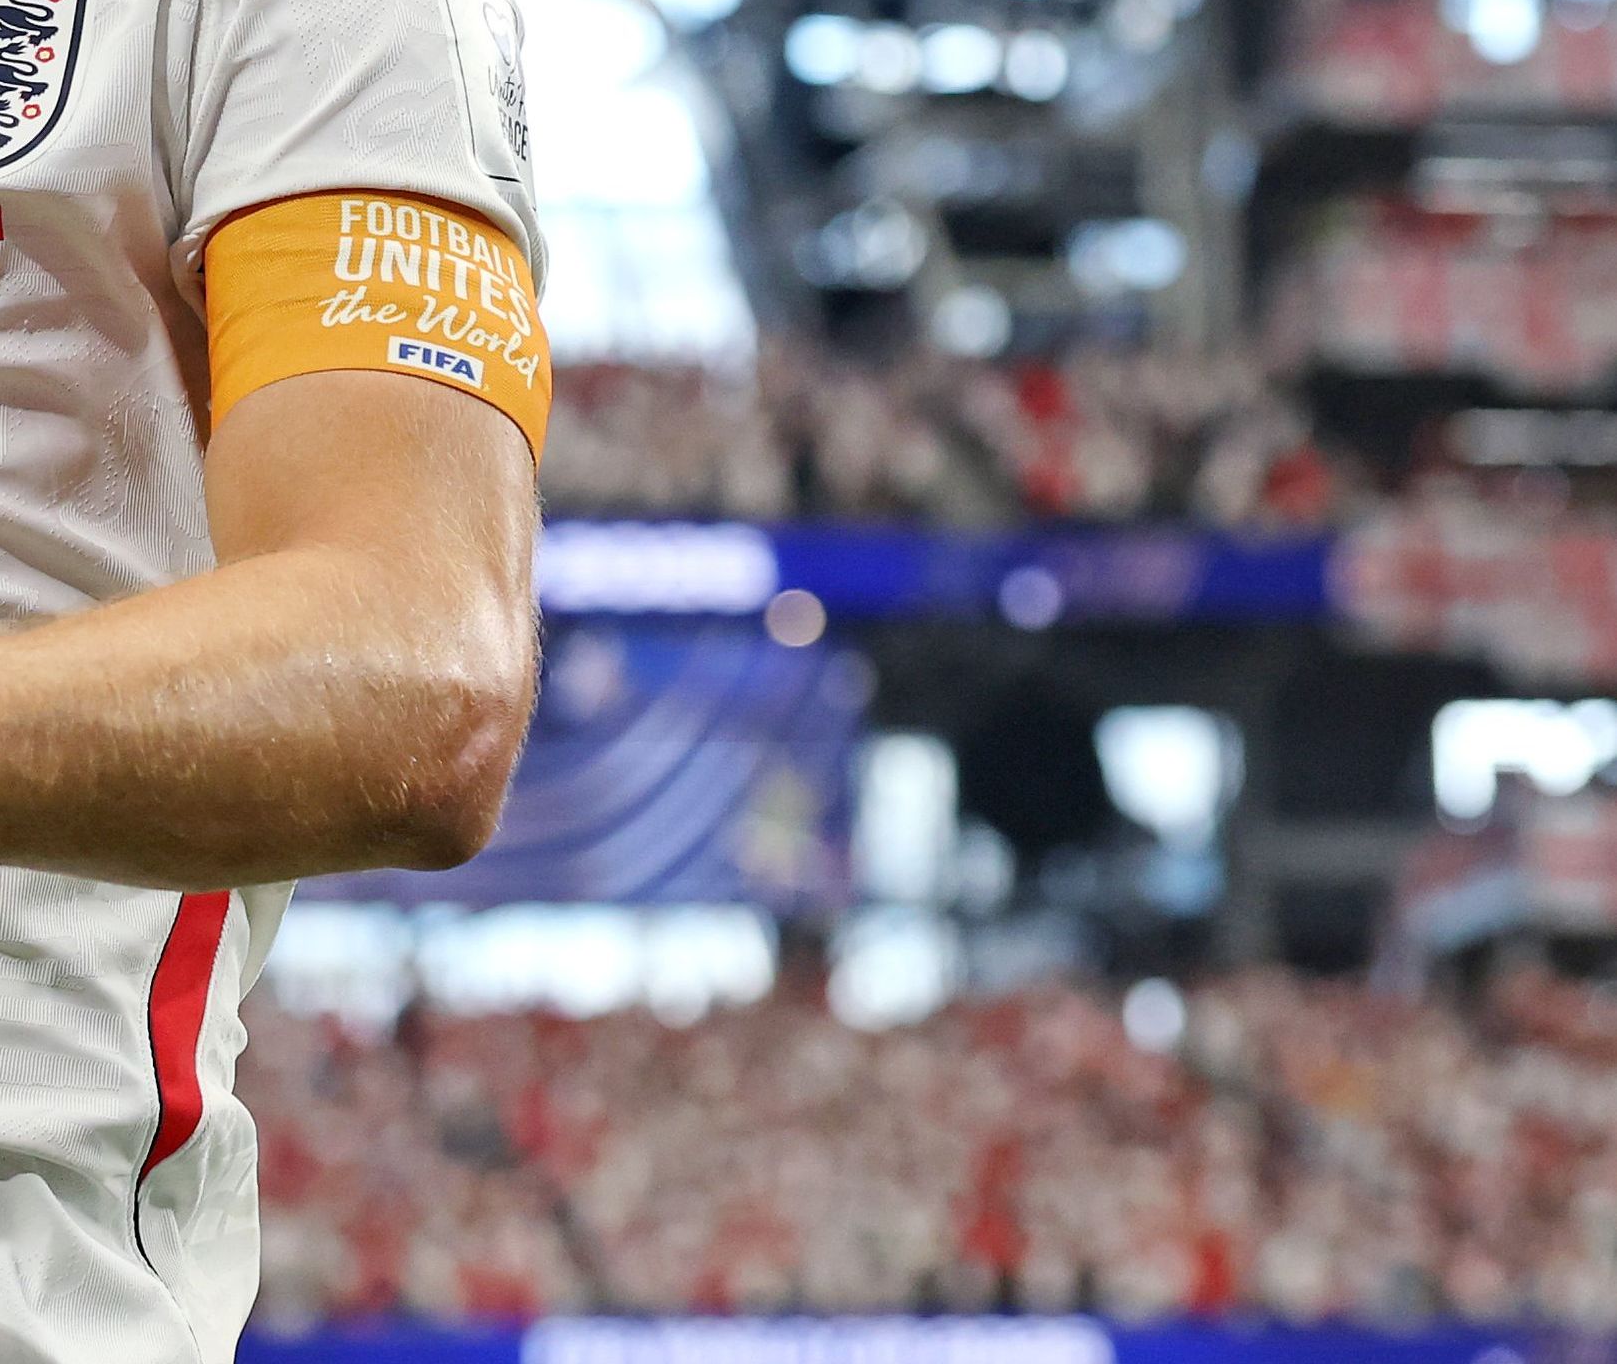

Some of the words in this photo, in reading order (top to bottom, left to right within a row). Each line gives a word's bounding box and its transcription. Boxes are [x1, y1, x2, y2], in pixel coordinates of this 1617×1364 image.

[334, 236, 532, 337] UNITES
[340, 199, 531, 292] FOOTBALL
[318, 286, 408, 329] the
[417, 295, 540, 391] World
[398, 342, 477, 383] FIFA
